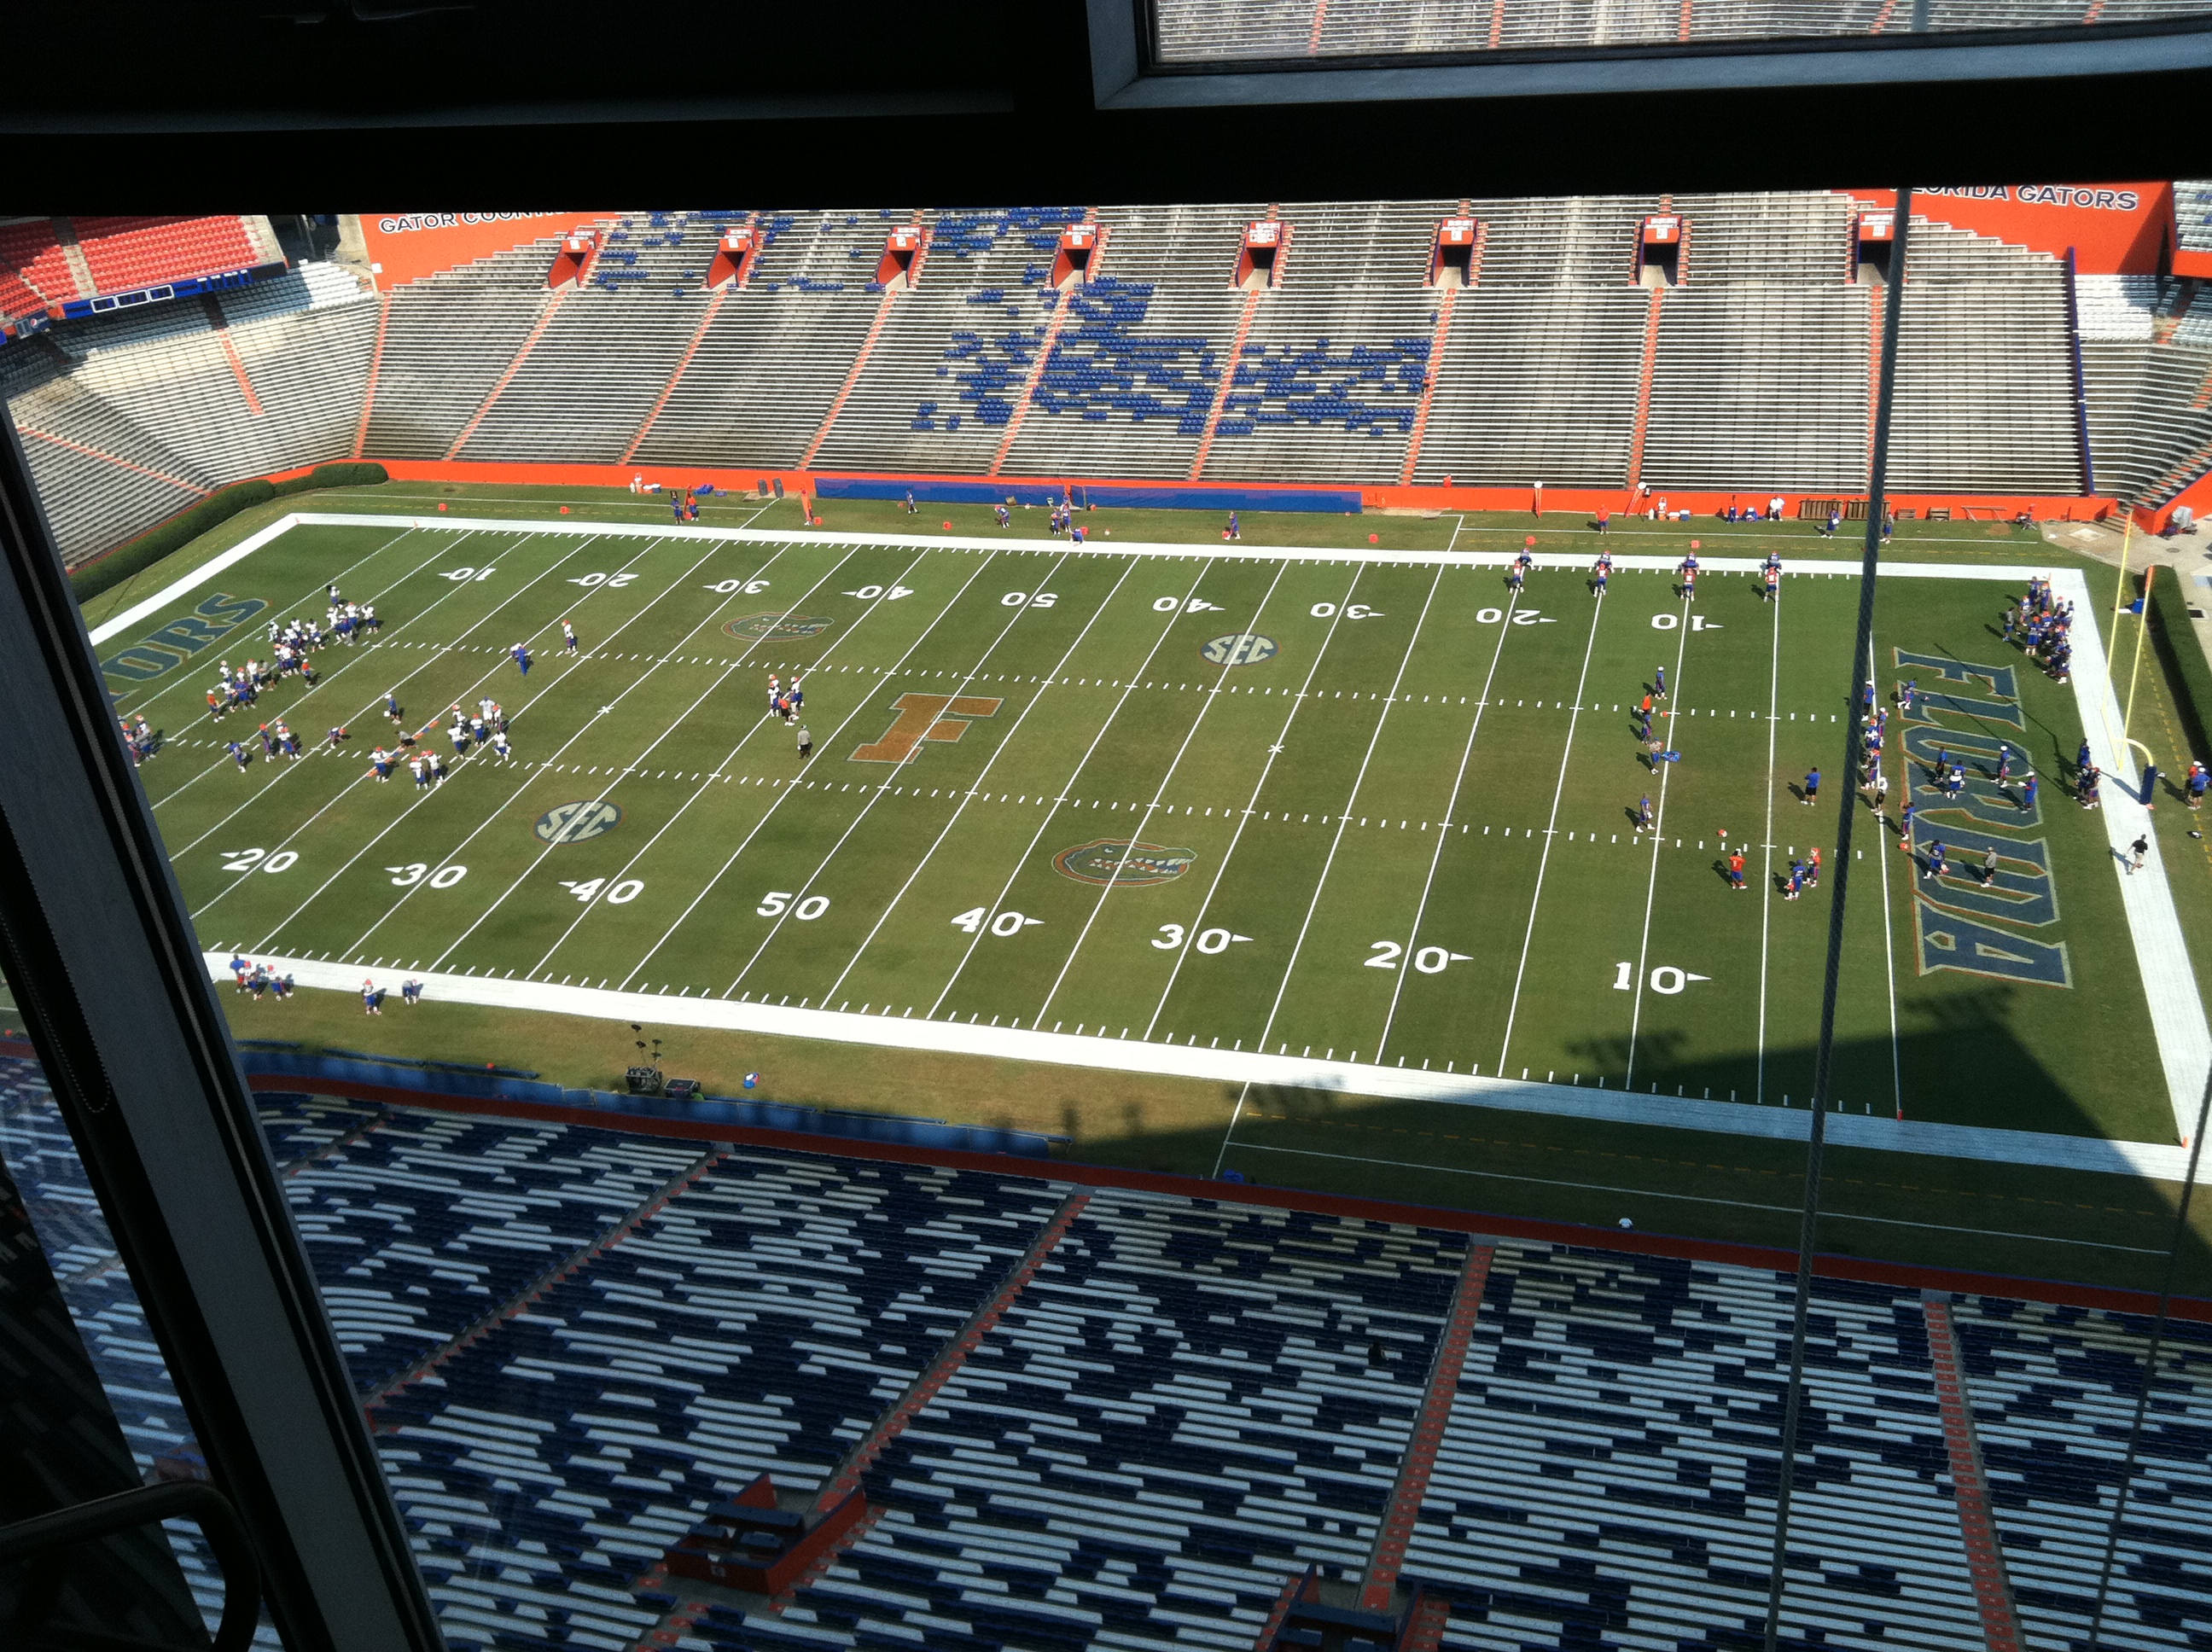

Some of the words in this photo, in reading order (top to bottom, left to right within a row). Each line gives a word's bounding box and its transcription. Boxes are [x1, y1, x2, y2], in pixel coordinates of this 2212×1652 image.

[2017, 184, 2139, 211] GATORS
[380, 212, 457, 233] GATOR
[449, 567, 498, 583] 10
[579, 573, 639, 589] 20
[714, 579, 770, 595] 30
[856, 585, 915, 601] 40
[1001, 592, 1059, 608] 50
[1153, 596, 1213, 614] 40
[1310, 602, 1372, 620] 30
[1476, 608, 1545, 625] 20
[1651, 613, 1715, 631] 10
[98, 591, 273, 705] ORS
[1202, 634, 1276, 665] SEC
[847, 692, 1004, 765] F
[537, 800, 619, 842] SEC
[1893, 646, 2075, 990] FLORIDA
[222, 847, 300, 874] 20
[393, 863, 469, 889] 30
[568, 877, 645, 905] 40
[756, 891, 830, 921] 50
[950, 906, 1025, 937] 40
[1150, 923, 1231, 955] 30
[1363, 940, 1449, 974] 20
[1612, 961, 1685, 995] 10
